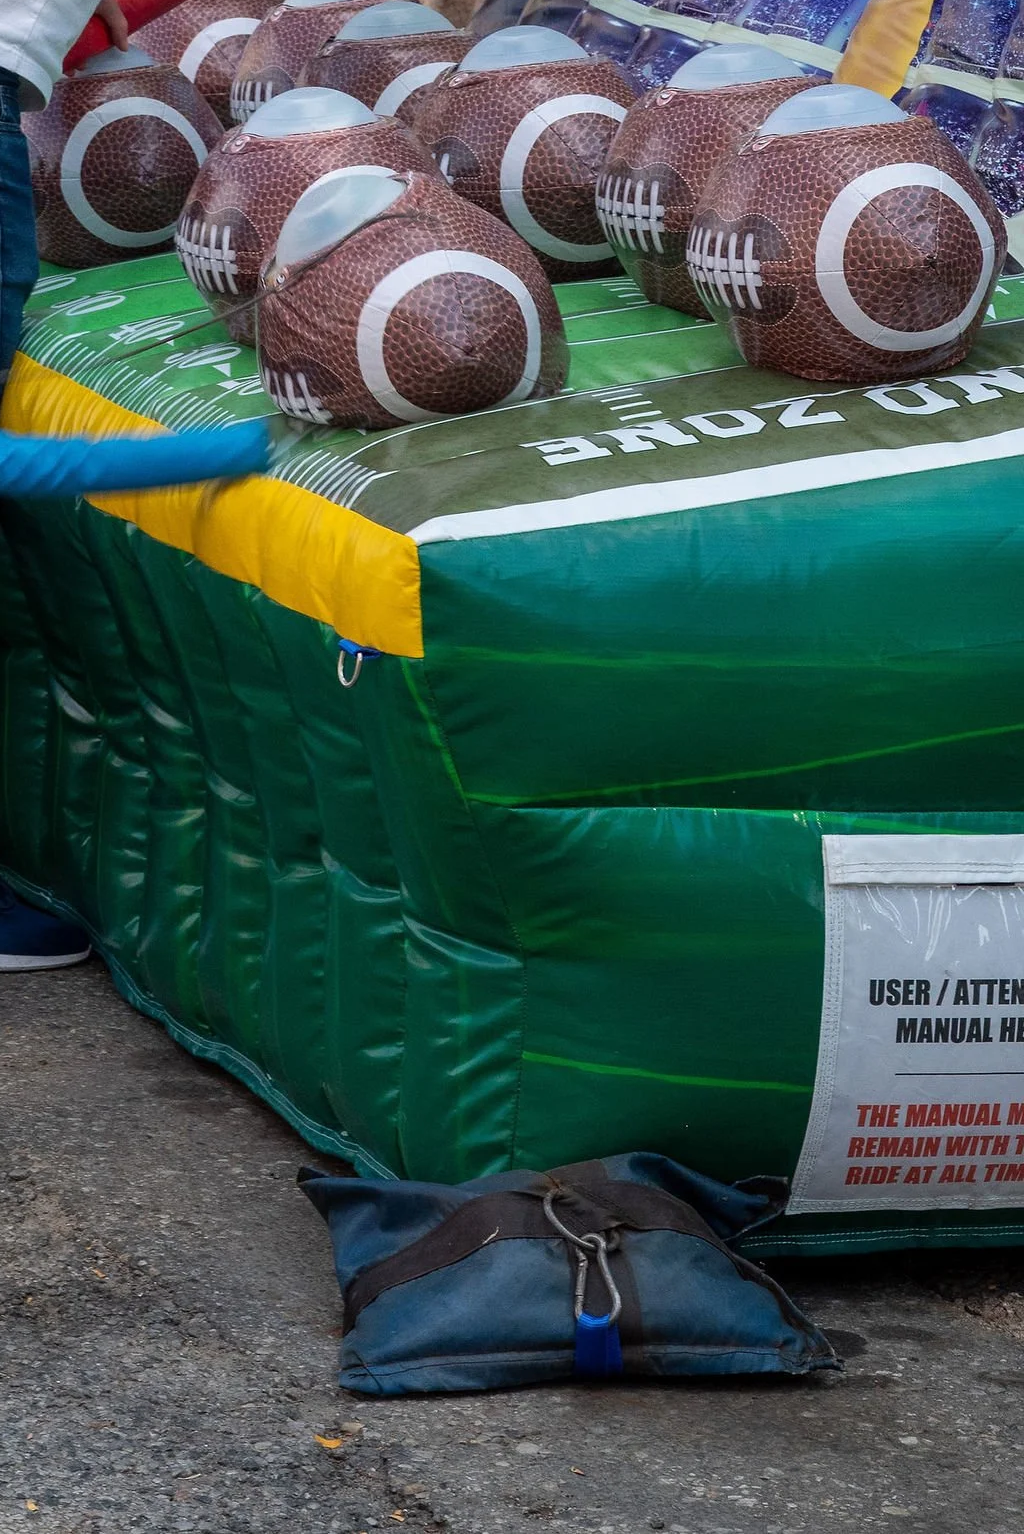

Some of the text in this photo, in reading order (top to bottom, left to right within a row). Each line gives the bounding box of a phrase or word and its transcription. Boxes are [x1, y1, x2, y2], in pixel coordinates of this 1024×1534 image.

[520, 398, 847, 467] ZONE
[869, 978, 1024, 1006] USER / ATTEN
[895, 1017, 1024, 1043] MANUAL HE
[857, 1104, 901, 1127] THE
[904, 1103, 1001, 1127] MANUAL
[847, 1136, 942, 1158] REMAIN
[944, 1135, 1011, 1156] WITH
[844, 1163, 1024, 1185] RIDE AT ALL TIM
